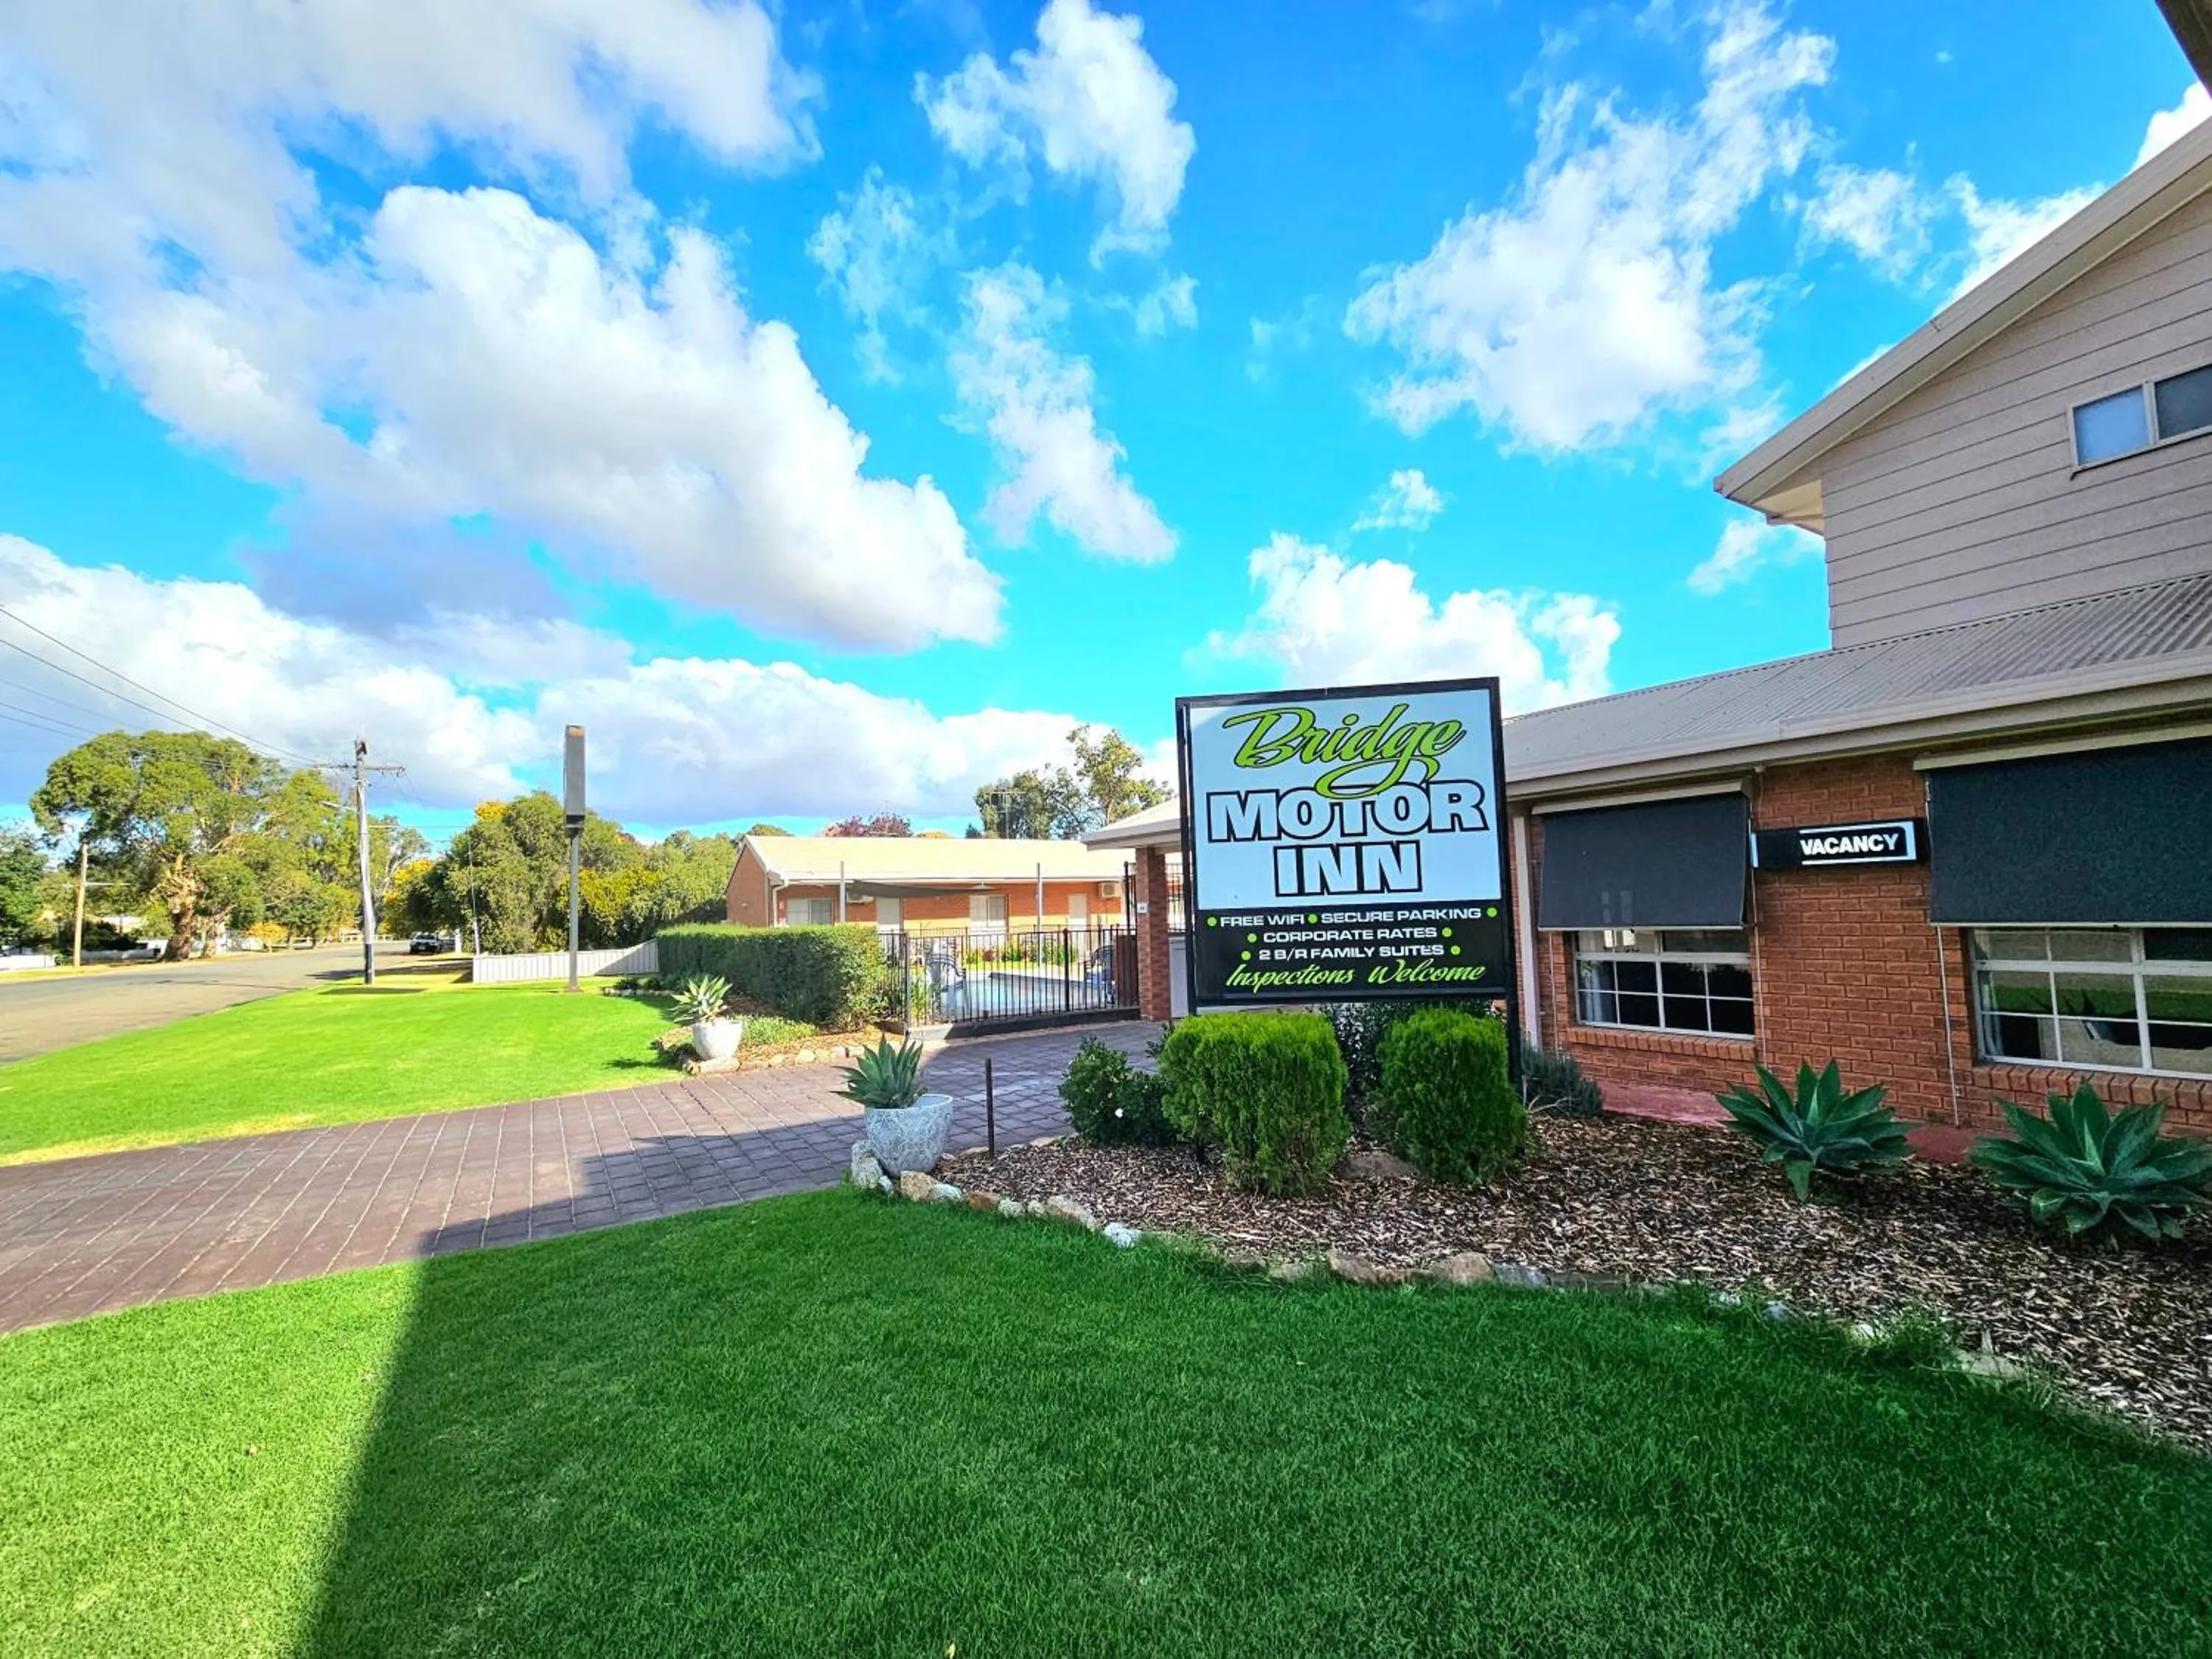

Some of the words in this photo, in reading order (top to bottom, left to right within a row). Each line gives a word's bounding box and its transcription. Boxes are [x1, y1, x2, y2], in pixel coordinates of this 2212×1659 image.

[1222, 703, 1467, 799] Bridge
[1206, 779, 1489, 844] MOTOR
[1800, 833, 1899, 855] VACANCY
[1273, 840, 1422, 897] INN
[1220, 915, 1265, 927] FREE
[1267, 914, 1304, 925] WIFI
[1321, 911, 1394, 923] SECURE
[1397, 908, 1481, 921] PARKING
[1263, 930, 1373, 943] CORPORATE
[1377, 927, 1437, 939] RATES
[1259, 950, 1271, 960] 2
[1274, 948, 1307, 961] B/R
[1310, 947, 1375, 959] FAMILY
[1380, 945, 1444, 956] SUITES
[1226, 963, 1355, 994] Inspections
[1368, 958, 1486, 984] Welcome
